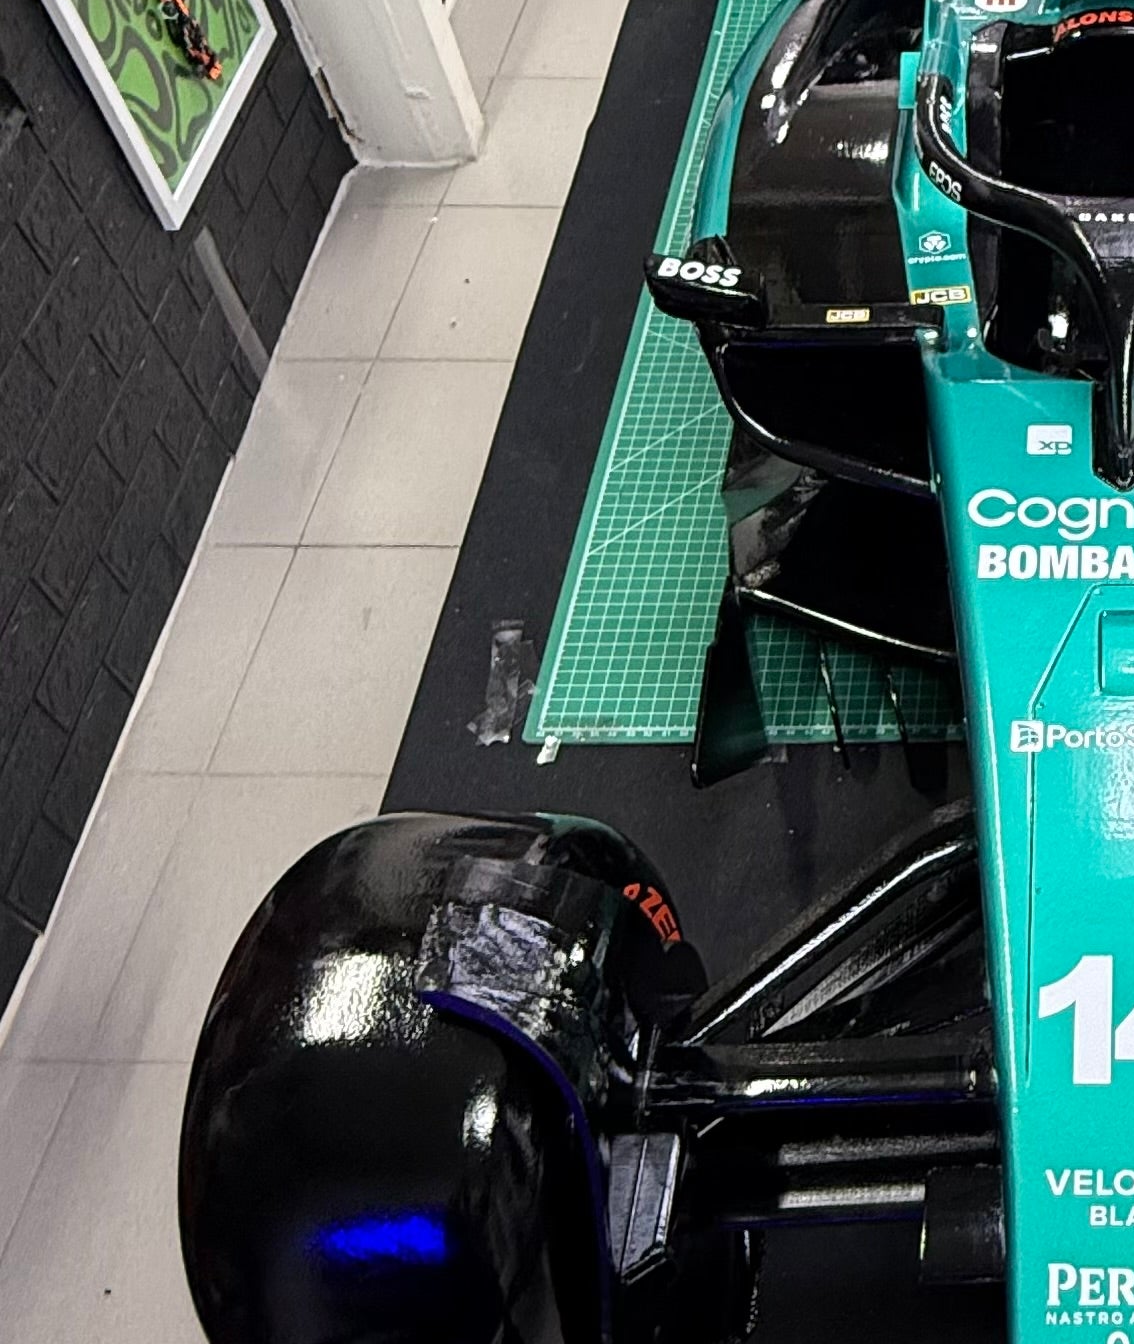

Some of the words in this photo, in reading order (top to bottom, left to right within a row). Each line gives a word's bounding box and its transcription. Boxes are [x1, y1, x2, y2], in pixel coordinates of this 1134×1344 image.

[657, 257, 742, 287] BOSS
[913, 288, 970, 305] JCB
[1046, 1311, 1124, 1325] NASTRO
